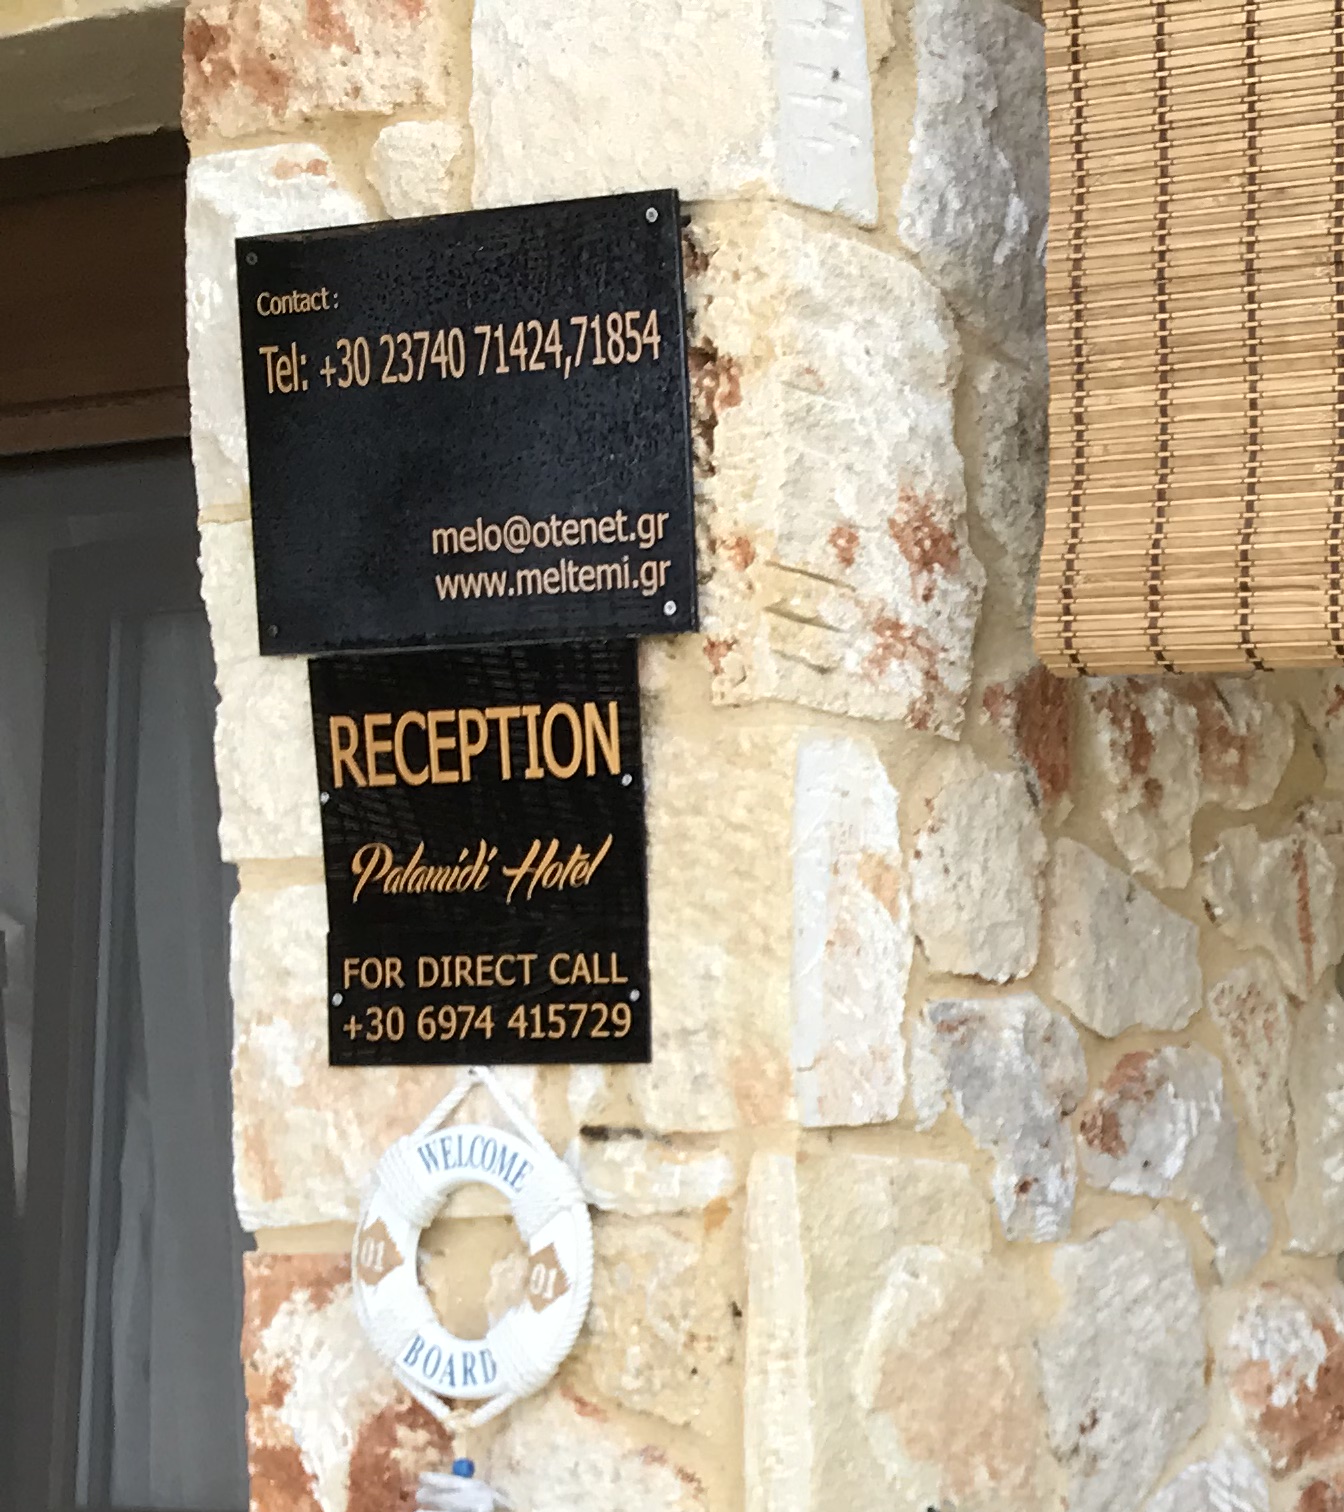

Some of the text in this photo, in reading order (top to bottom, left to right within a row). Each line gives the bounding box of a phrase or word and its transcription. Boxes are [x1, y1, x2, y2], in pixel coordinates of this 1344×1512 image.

[259, 309, 662, 394] Tel: +30 23740 71424,71854
[431, 509, 670, 555] melo@otenet.gr
[434, 555, 671, 600] www.meltemi.gr
[329, 701, 622, 789] RECEPTION
[351, 833, 614, 905] Palamidi Hotel
[343, 952, 629, 990] FOR DIRECT CALL
[343, 1002, 633, 1042] +30 6974 415729
[416, 1134, 535, 1194] WELCOME
[402, 1333, 499, 1390] BOARD
